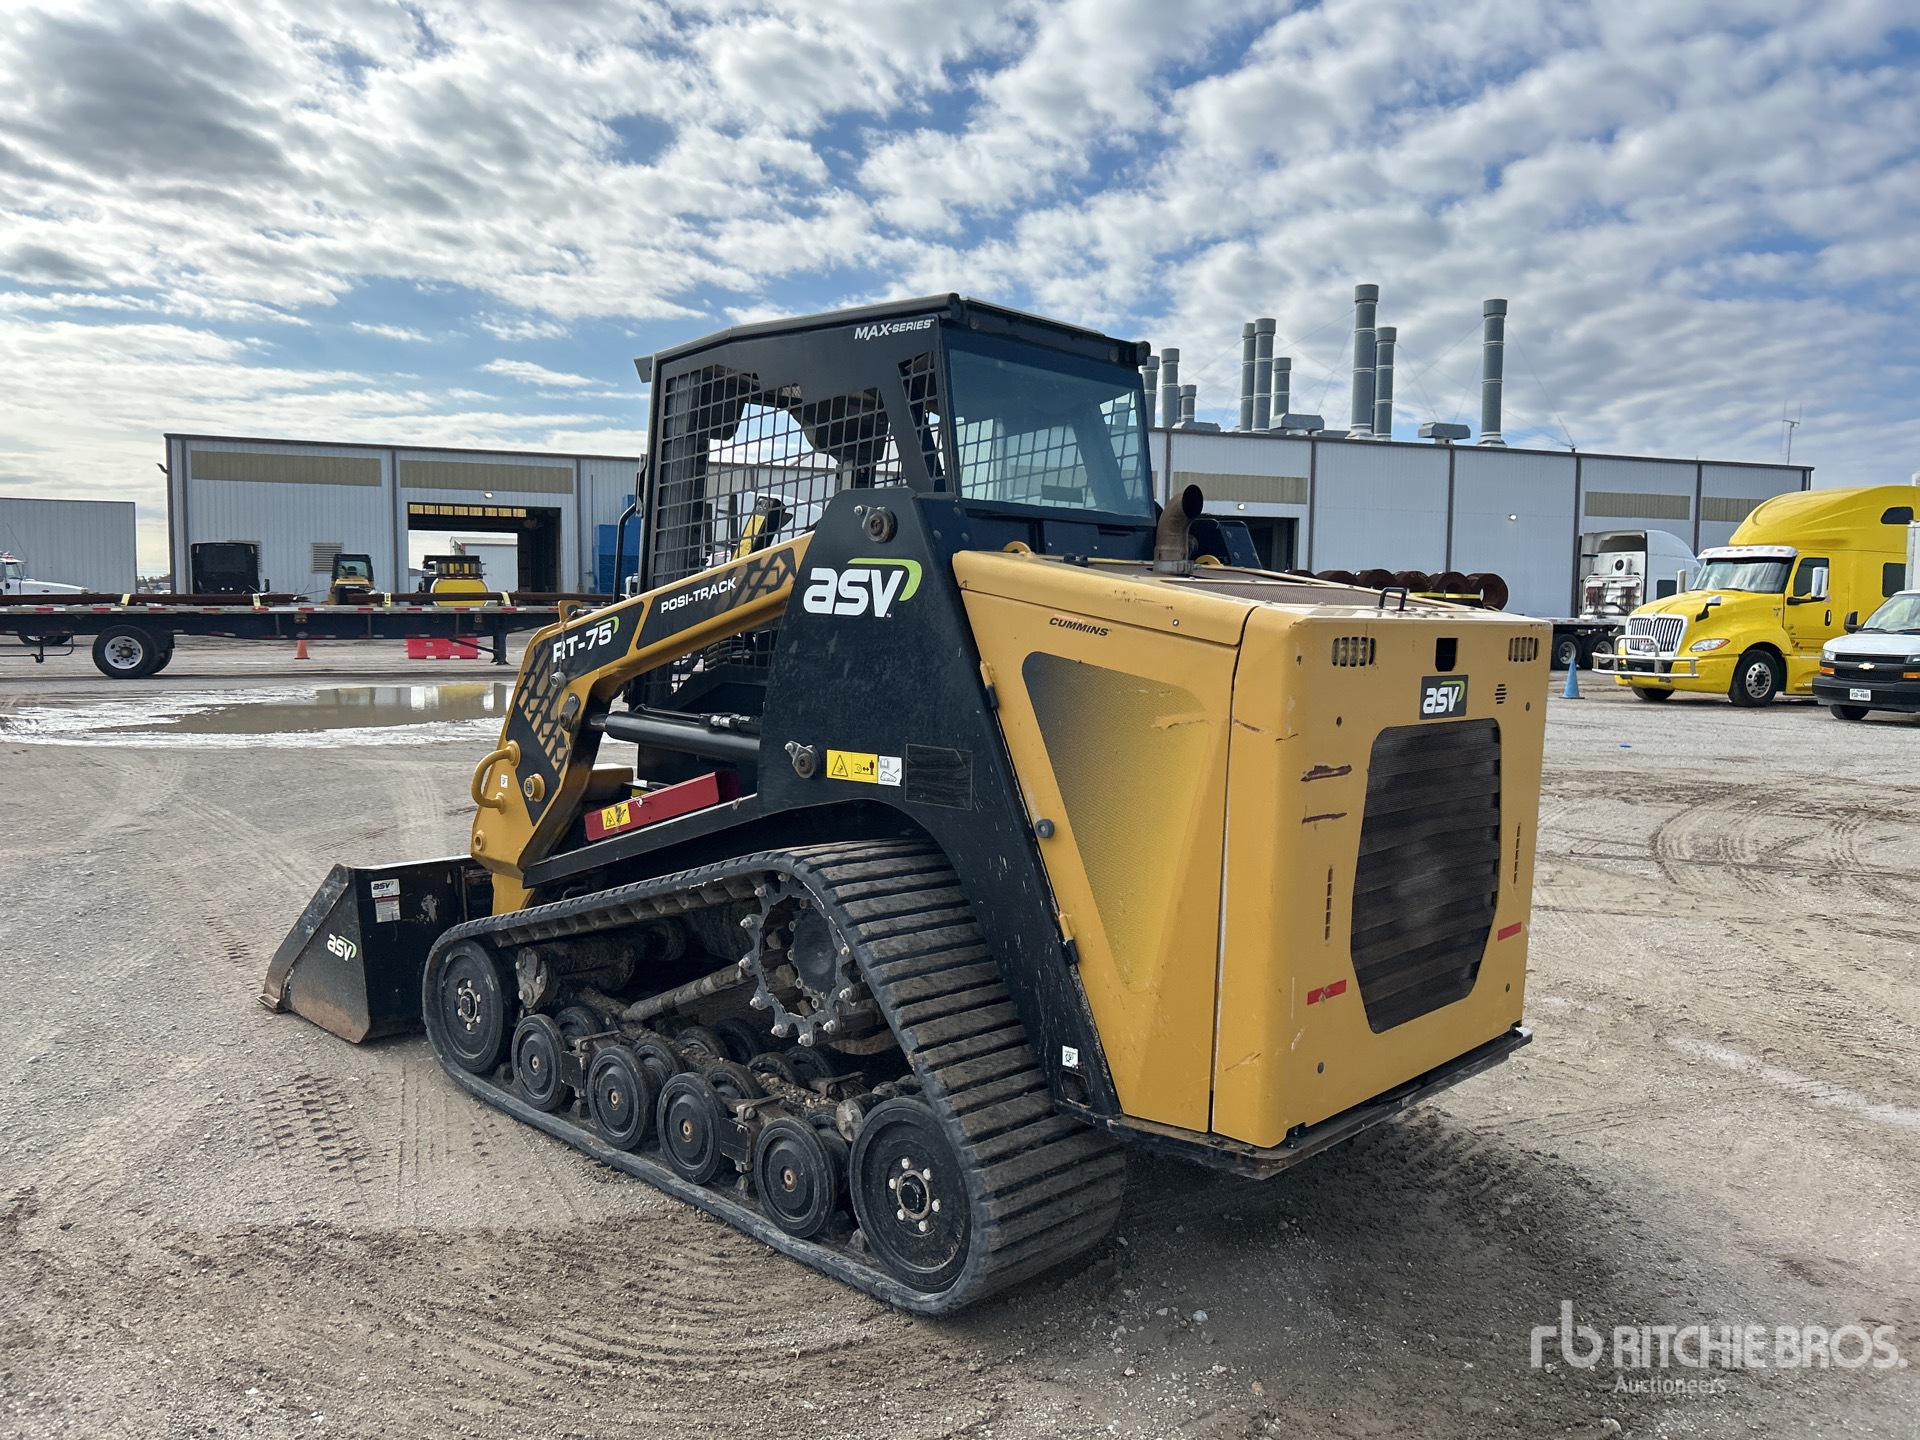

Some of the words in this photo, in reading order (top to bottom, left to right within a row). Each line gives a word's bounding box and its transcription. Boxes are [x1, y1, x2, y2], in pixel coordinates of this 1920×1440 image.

[854, 319, 933, 341] MAX-SERIES
[660, 576, 737, 614] POSI-TRACK
[1049, 617, 1109, 637] CUMMINS
[552, 622, 612, 664] RT-75
